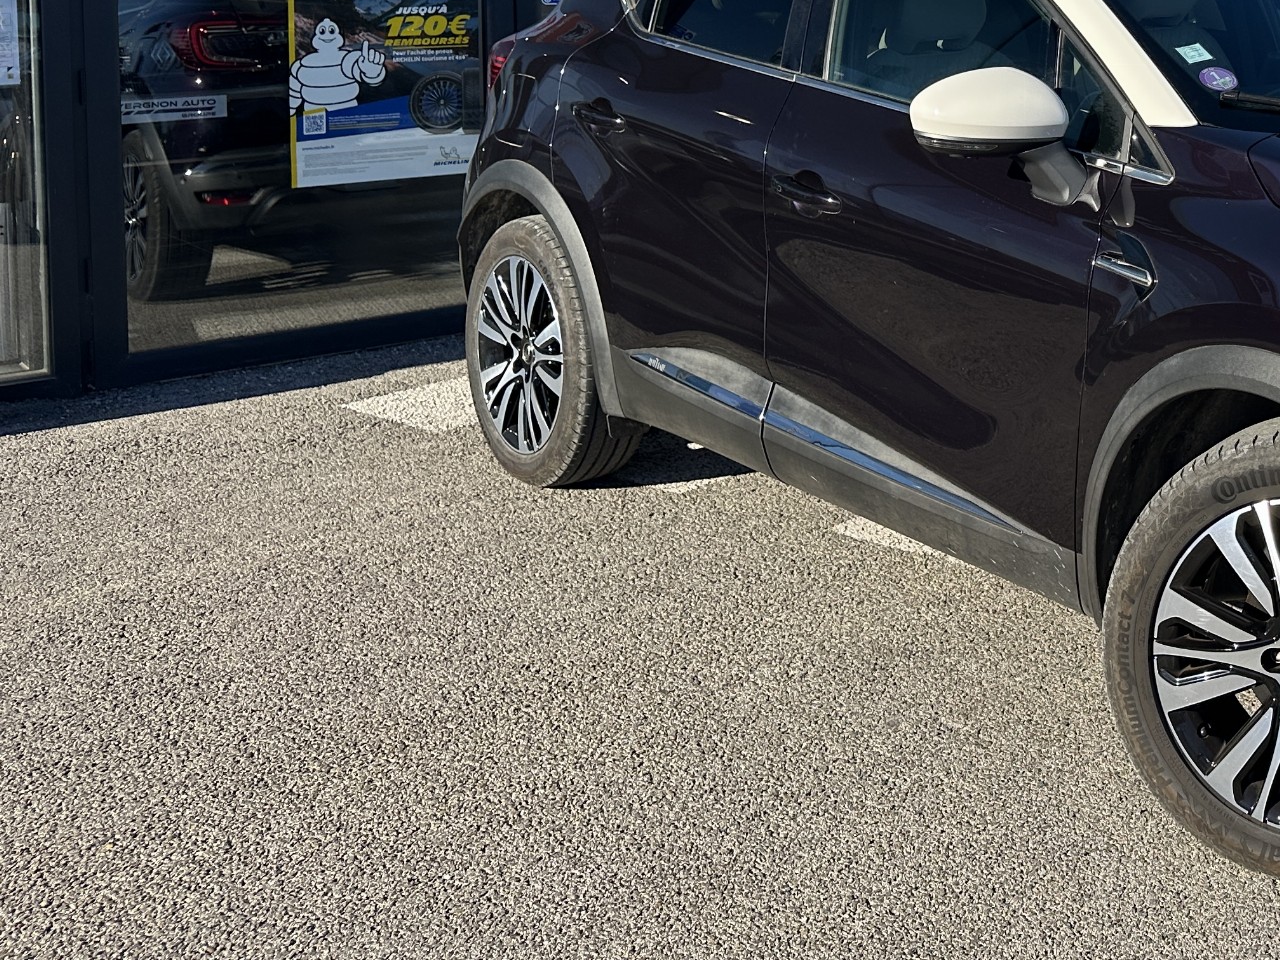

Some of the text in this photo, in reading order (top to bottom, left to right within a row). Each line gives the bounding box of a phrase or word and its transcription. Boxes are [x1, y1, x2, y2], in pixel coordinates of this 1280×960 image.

[395, 4, 448, 16] JUSQU'À
[386, 14, 471, 38] 120€
[384, 35, 470, 47] REMBOURSÉS
[181, 99, 217, 107] AUTO
[433, 159, 469, 167] MICHELIN
